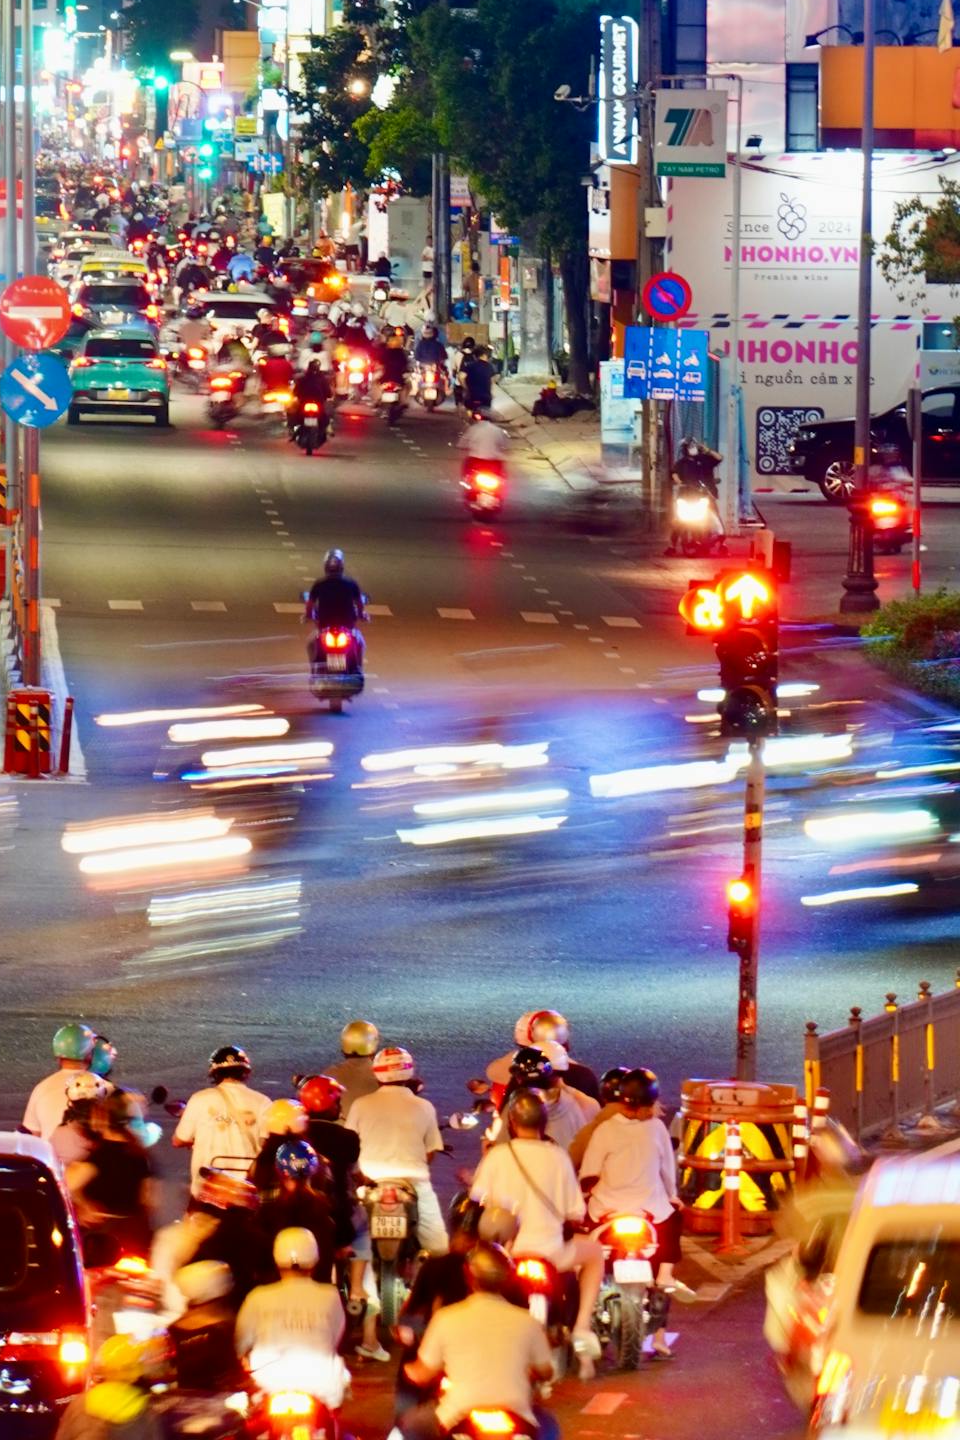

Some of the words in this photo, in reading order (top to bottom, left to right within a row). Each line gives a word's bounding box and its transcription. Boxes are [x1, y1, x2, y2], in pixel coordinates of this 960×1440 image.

[612, 22, 628, 96] GOURMET
[726, 220, 769, 233] Snce
[818, 220, 852, 233] 2024
[754, 369, 803, 387] nguồn
[810, 371, 838, 385] cảm
